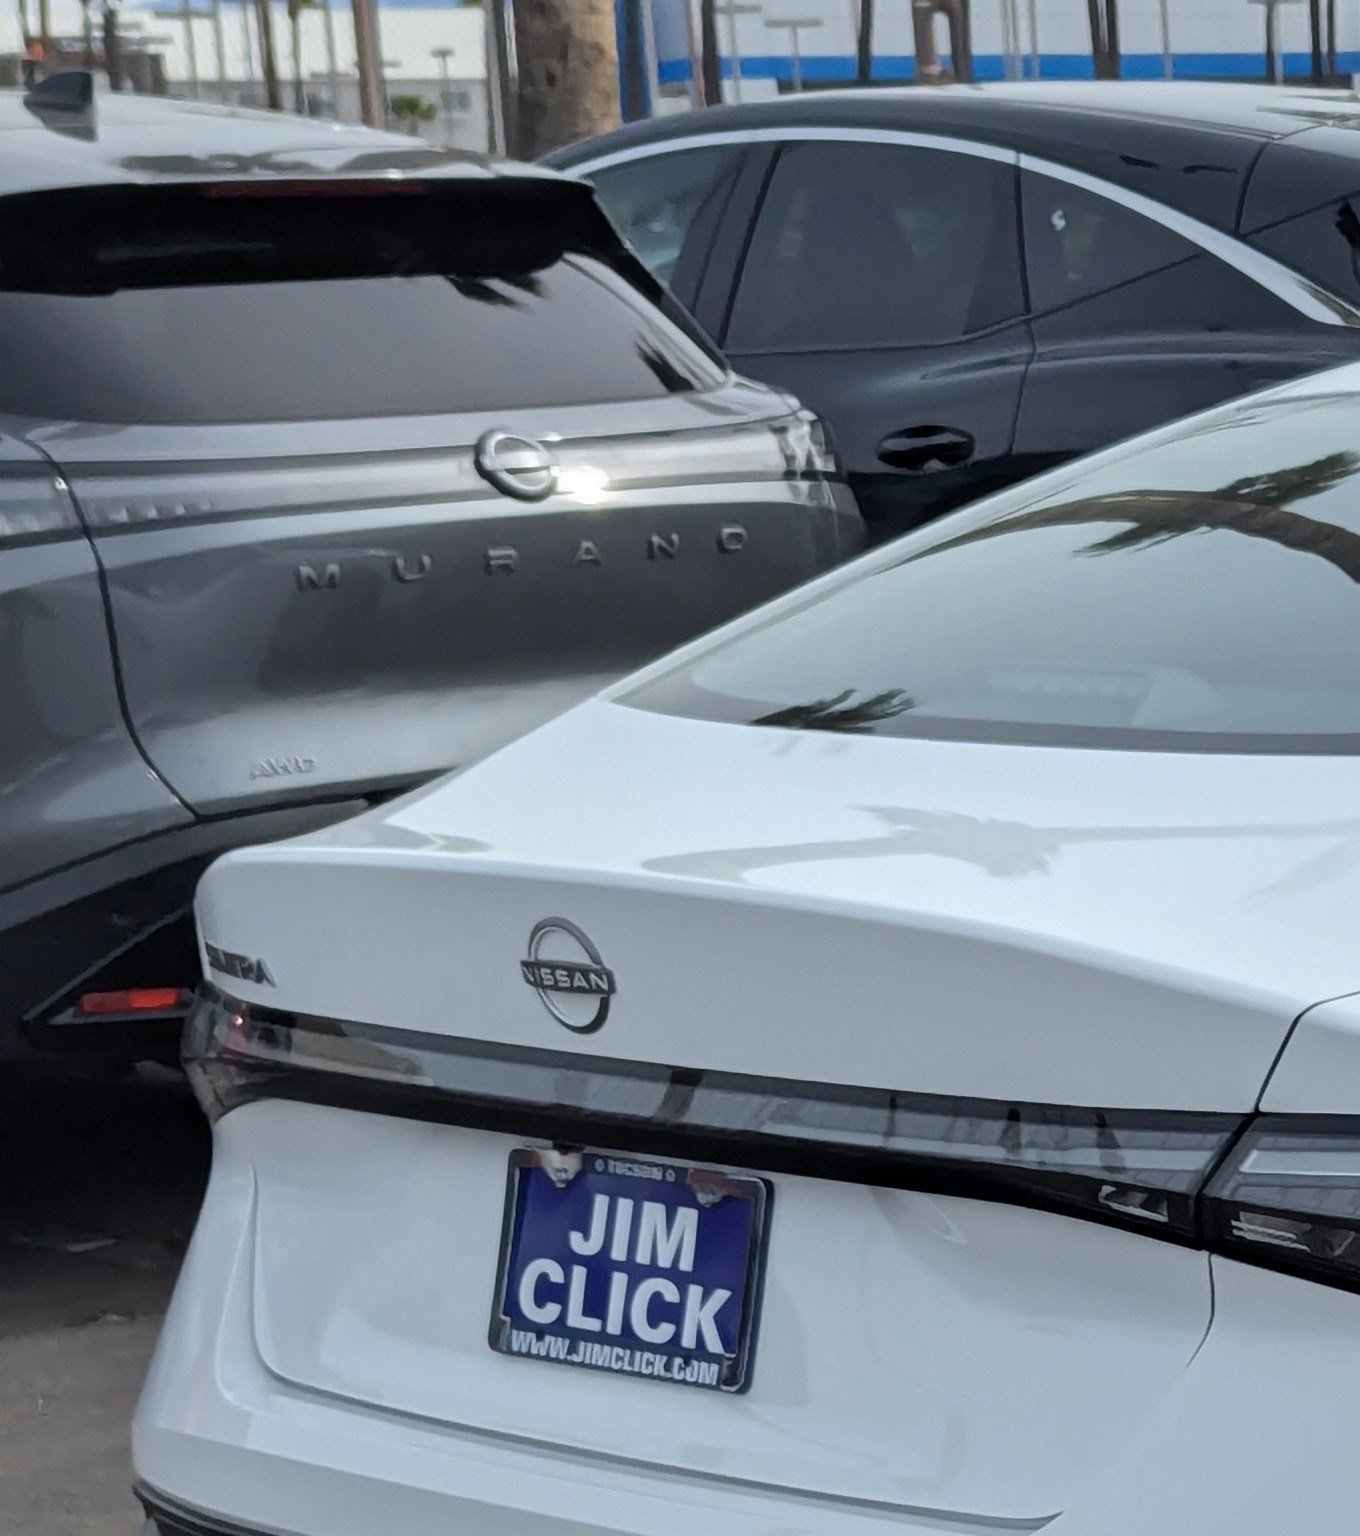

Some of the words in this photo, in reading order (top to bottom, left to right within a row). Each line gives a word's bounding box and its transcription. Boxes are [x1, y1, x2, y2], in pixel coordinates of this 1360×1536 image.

[297, 521, 748, 591] MURANO
[521, 964, 610, 992] NISSAN
[569, 1193, 699, 1272] JIM
[518, 1258, 732, 1354] CLICK
[511, 1329, 719, 1386] WWW.JIMCLICK.COM
